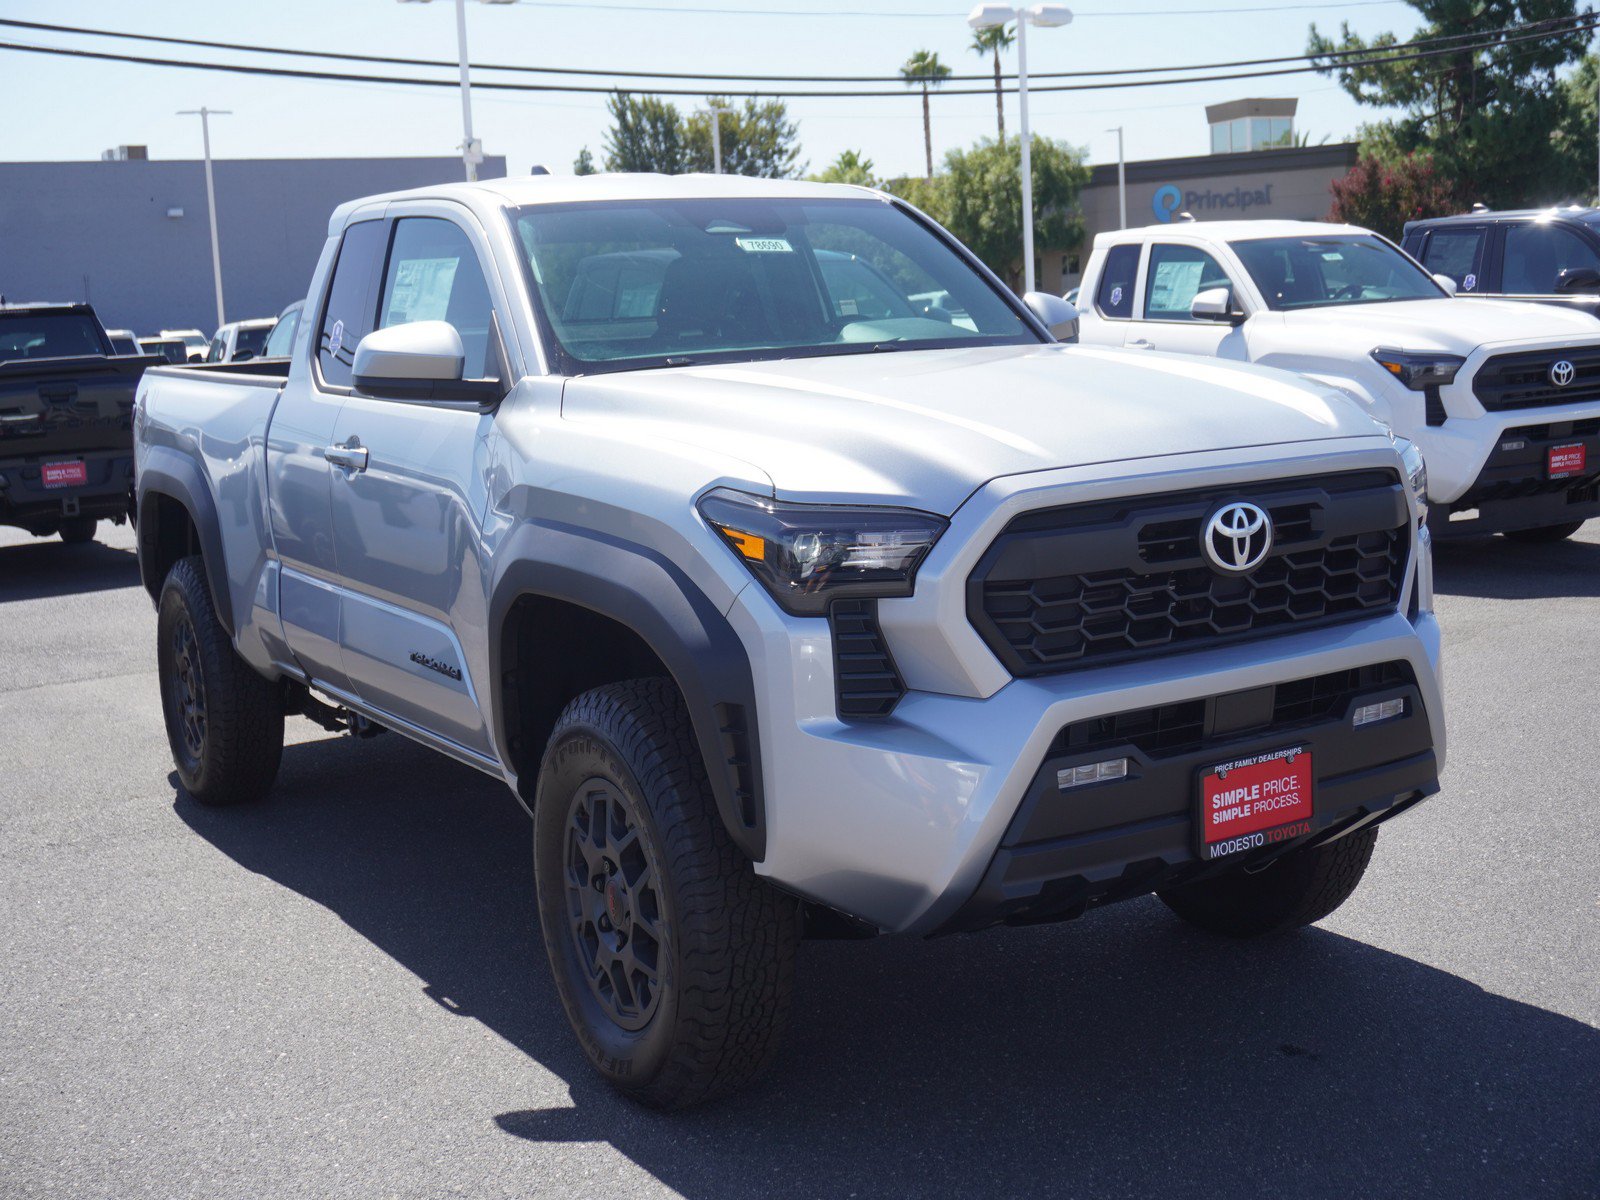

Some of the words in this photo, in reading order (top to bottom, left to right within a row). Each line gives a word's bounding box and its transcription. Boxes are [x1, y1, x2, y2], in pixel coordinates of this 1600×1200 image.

[1185, 184, 1272, 212] Principal
[746, 240, 784, 250] 78690
[1214, 763, 1233, 773] PRICE
[1234, 757, 1258, 769] FAMILY
[1258, 747, 1302, 763] DEALERSHIPS
[1212, 785, 1260, 809] SIMPLE
[1263, 775, 1301, 796] PRICE.
[1213, 804, 1251, 825] SIMPLE
[1253, 792, 1301, 814] PROCESS.
[1210, 833, 1264, 858] MODESTO
[1267, 822, 1311, 843] TOYOTA
